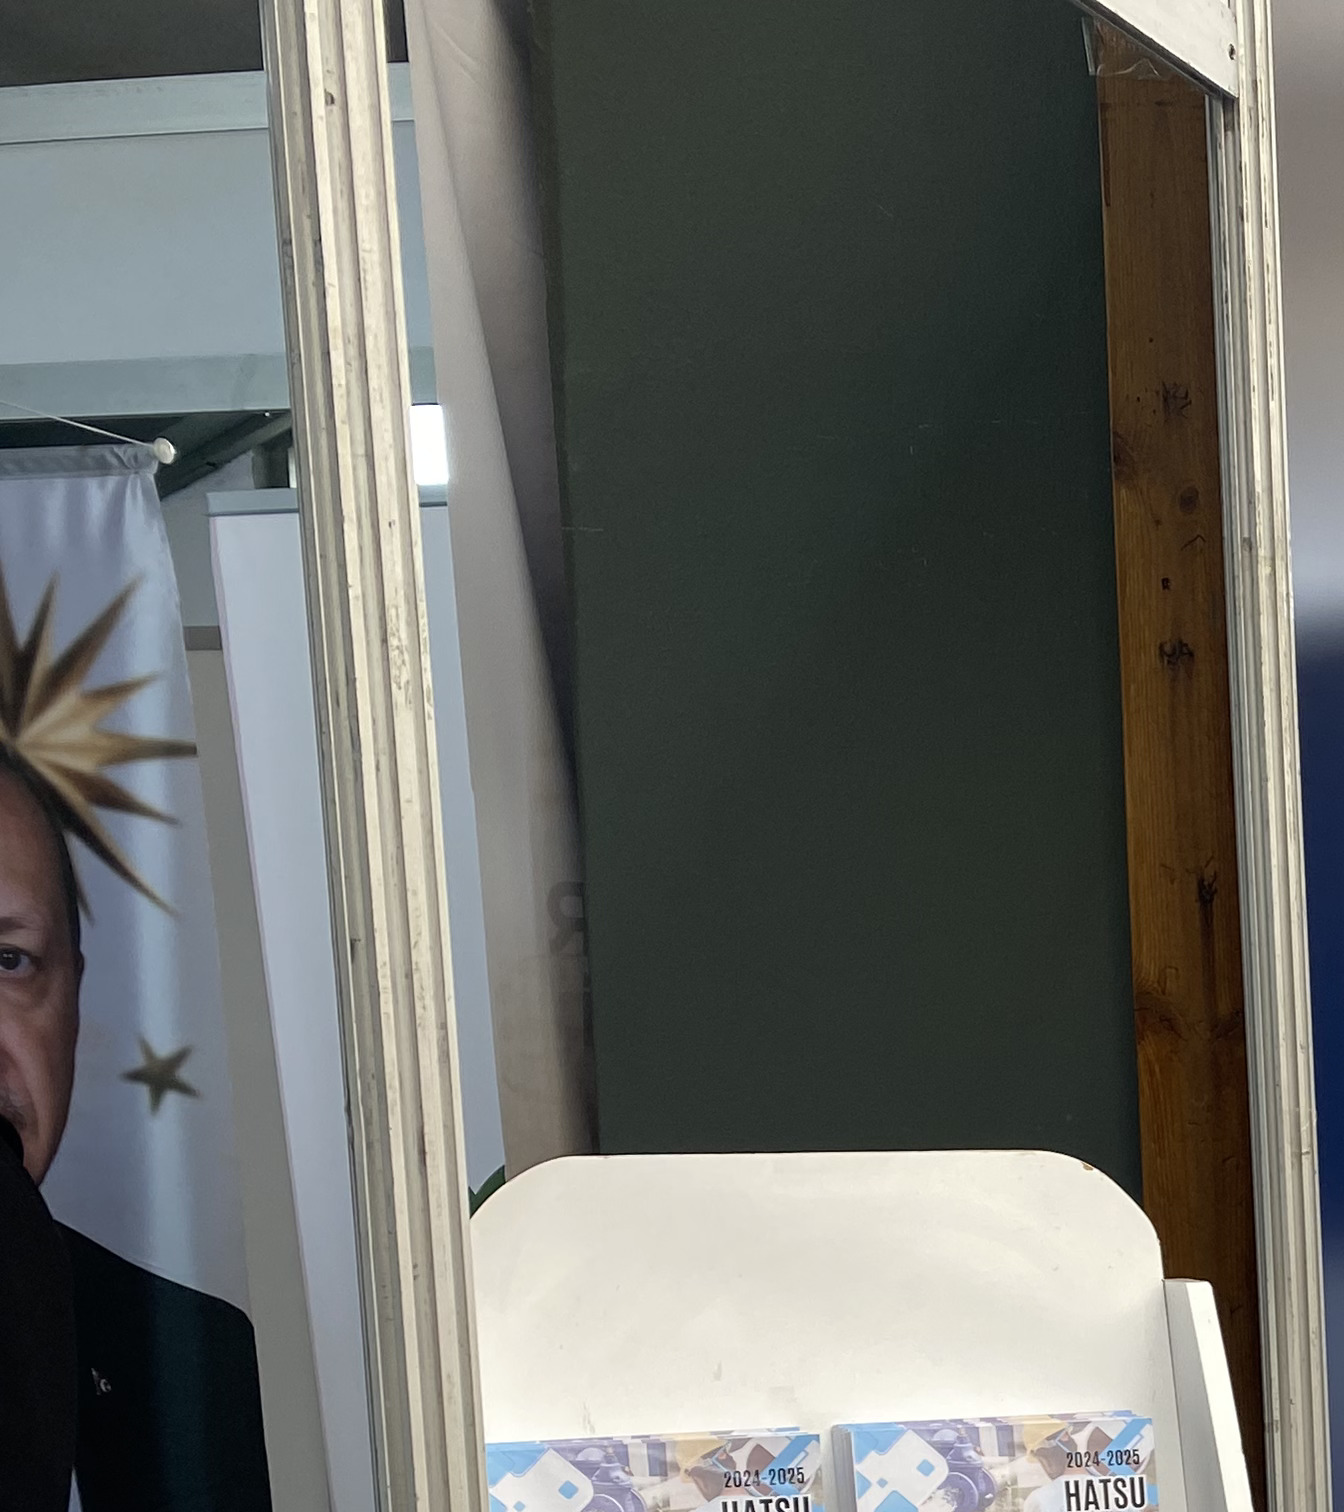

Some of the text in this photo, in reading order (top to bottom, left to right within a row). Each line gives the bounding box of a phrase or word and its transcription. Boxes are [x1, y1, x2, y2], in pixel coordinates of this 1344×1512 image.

[1066, 1449, 1141, 1468] 2024-2025
[723, 1467, 805, 1489] 2024-2025
[1064, 1477, 1146, 1512] HATSU
